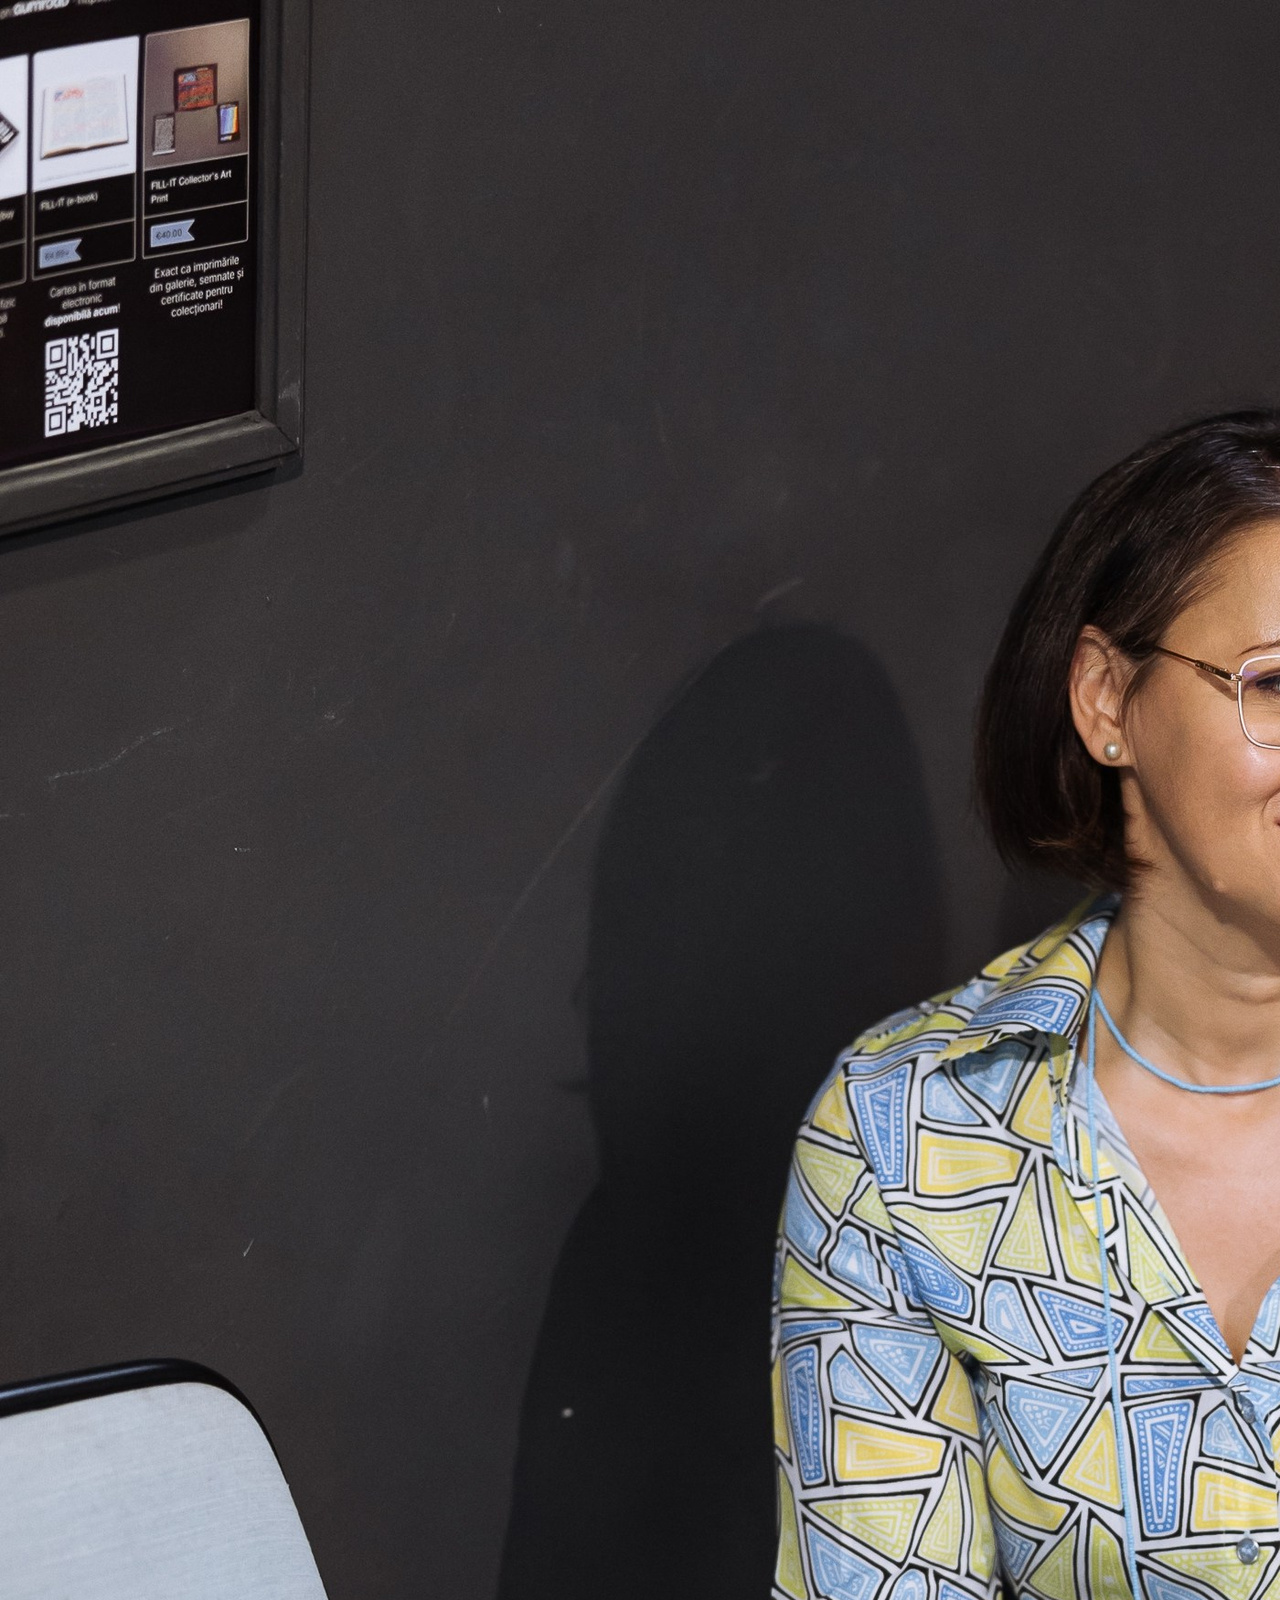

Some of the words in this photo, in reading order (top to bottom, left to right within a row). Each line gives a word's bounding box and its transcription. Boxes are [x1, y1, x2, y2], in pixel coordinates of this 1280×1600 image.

[178, 172, 219, 186] Collector's
[220, 169, 232, 179] Art
[151, 194, 169, 204] Print
[154, 266, 179, 279] Exact
[180, 266, 192, 275] ca
[49, 285, 77, 299] Cartea
[88, 277, 116, 290] format
[149, 282, 163, 294] din
[165, 277, 197, 293] galerie,
[199, 271, 235, 285] semnate
[61, 294, 103, 310] electronic
[160, 290, 204, 306] certificate
[205, 286, 233, 300] pentru
